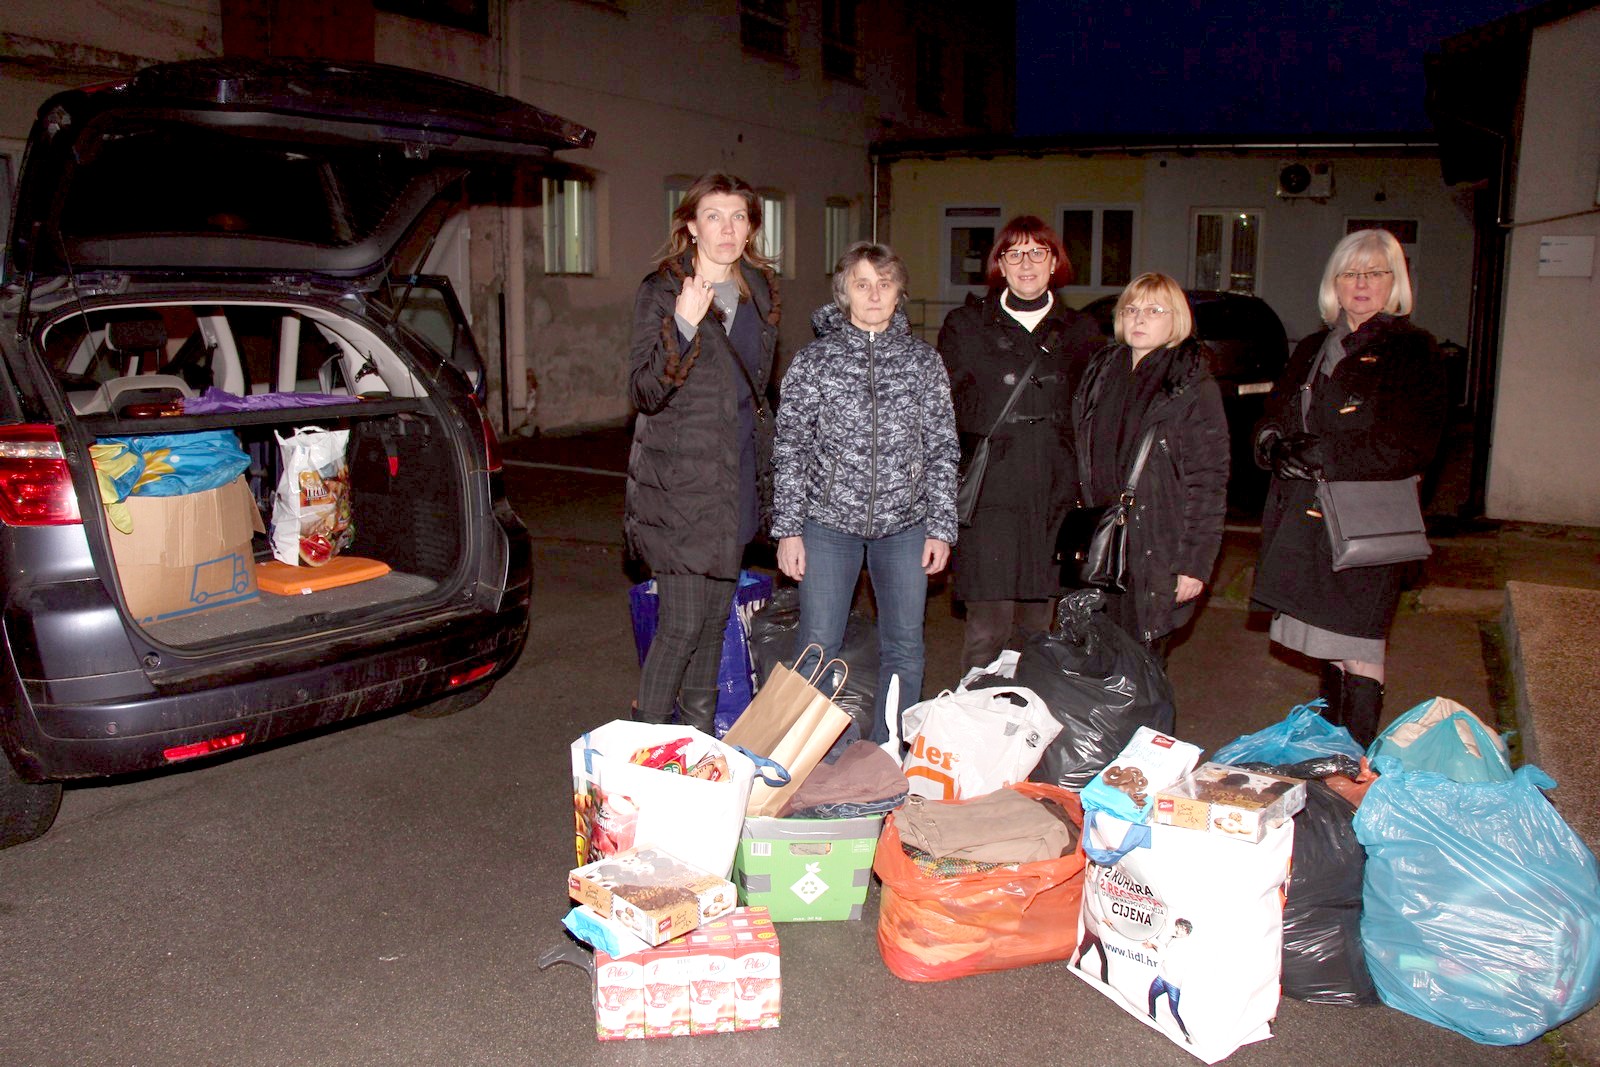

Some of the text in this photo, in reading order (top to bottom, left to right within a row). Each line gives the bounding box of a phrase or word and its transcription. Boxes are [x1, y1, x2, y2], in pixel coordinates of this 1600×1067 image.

[1100, 878, 1163, 908] 2 RECEPTA
[1104, 866, 1154, 897] 2 KUHARA
[1111, 902, 1153, 927] CIJENA
[1104, 941, 1158, 968] www.lidl.hr
